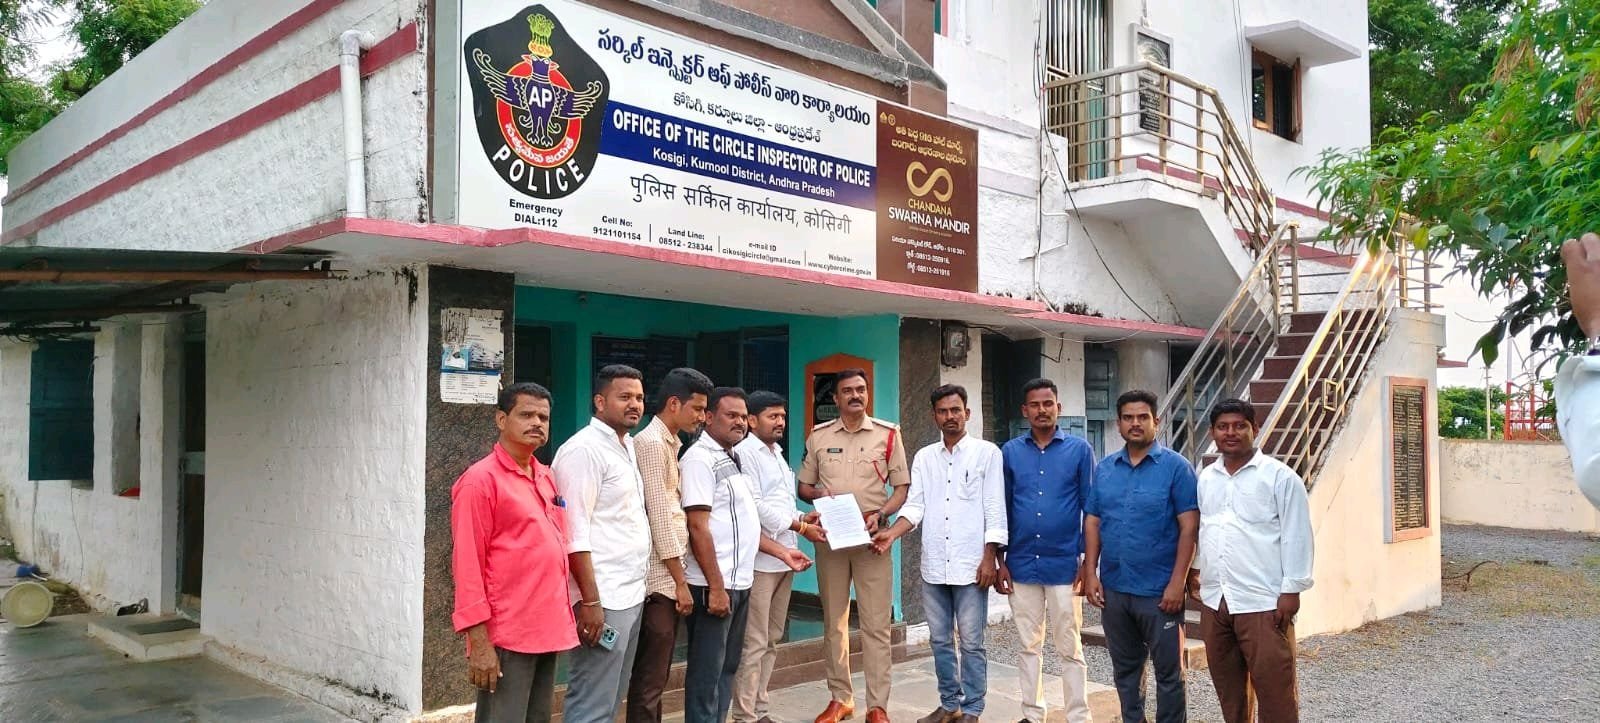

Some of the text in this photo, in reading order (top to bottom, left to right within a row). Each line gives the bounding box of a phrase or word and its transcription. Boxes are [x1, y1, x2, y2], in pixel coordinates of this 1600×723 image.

[598, 28, 645, 63] సర్కిల్
[708, 63, 731, 89] ఆఫ్
[734, 70, 771, 98] పోలీస్
[774, 84, 800, 106] వారి
[802, 95, 870, 126] కార్యాలయం
[528, 85, 553, 109] AP
[745, 112, 765, 135] జిల్లా
[613, 108, 870, 187] OFFICE OF THE CIRCLE INSPECTOR OF POLICE
[493, 144, 585, 194] POLICE
[653, 147, 835, 198] Kosigi, Kurnool District, Andhra Pradesh
[509, 198, 563, 217] Emergency
[630, 173, 852, 235] पुलिस सर्किल कार्यालय, कोसिगी
[908, 198, 953, 217] CHANDANA
[514, 212, 558, 228] DIAL:112
[601, 215, 633, 228] Cell No:
[888, 206, 932, 227] SWARNA
[934, 215, 970, 235] MANDIR
[667, 227, 705, 241] Land Line:
